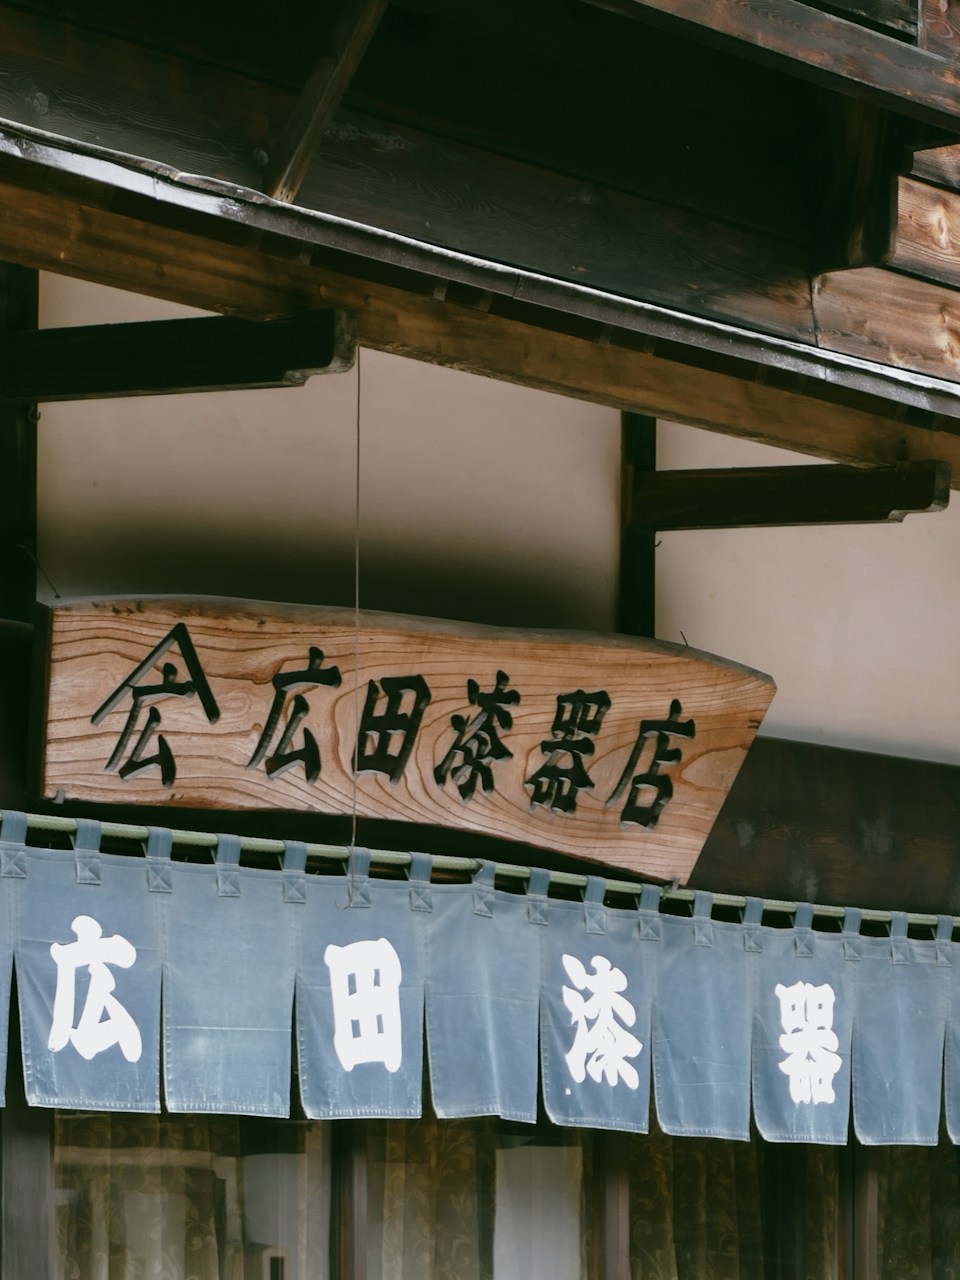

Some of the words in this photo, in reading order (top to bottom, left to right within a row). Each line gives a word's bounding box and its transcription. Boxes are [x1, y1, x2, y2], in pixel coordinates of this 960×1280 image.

[246, 646, 696, 831] 広田漆器店
